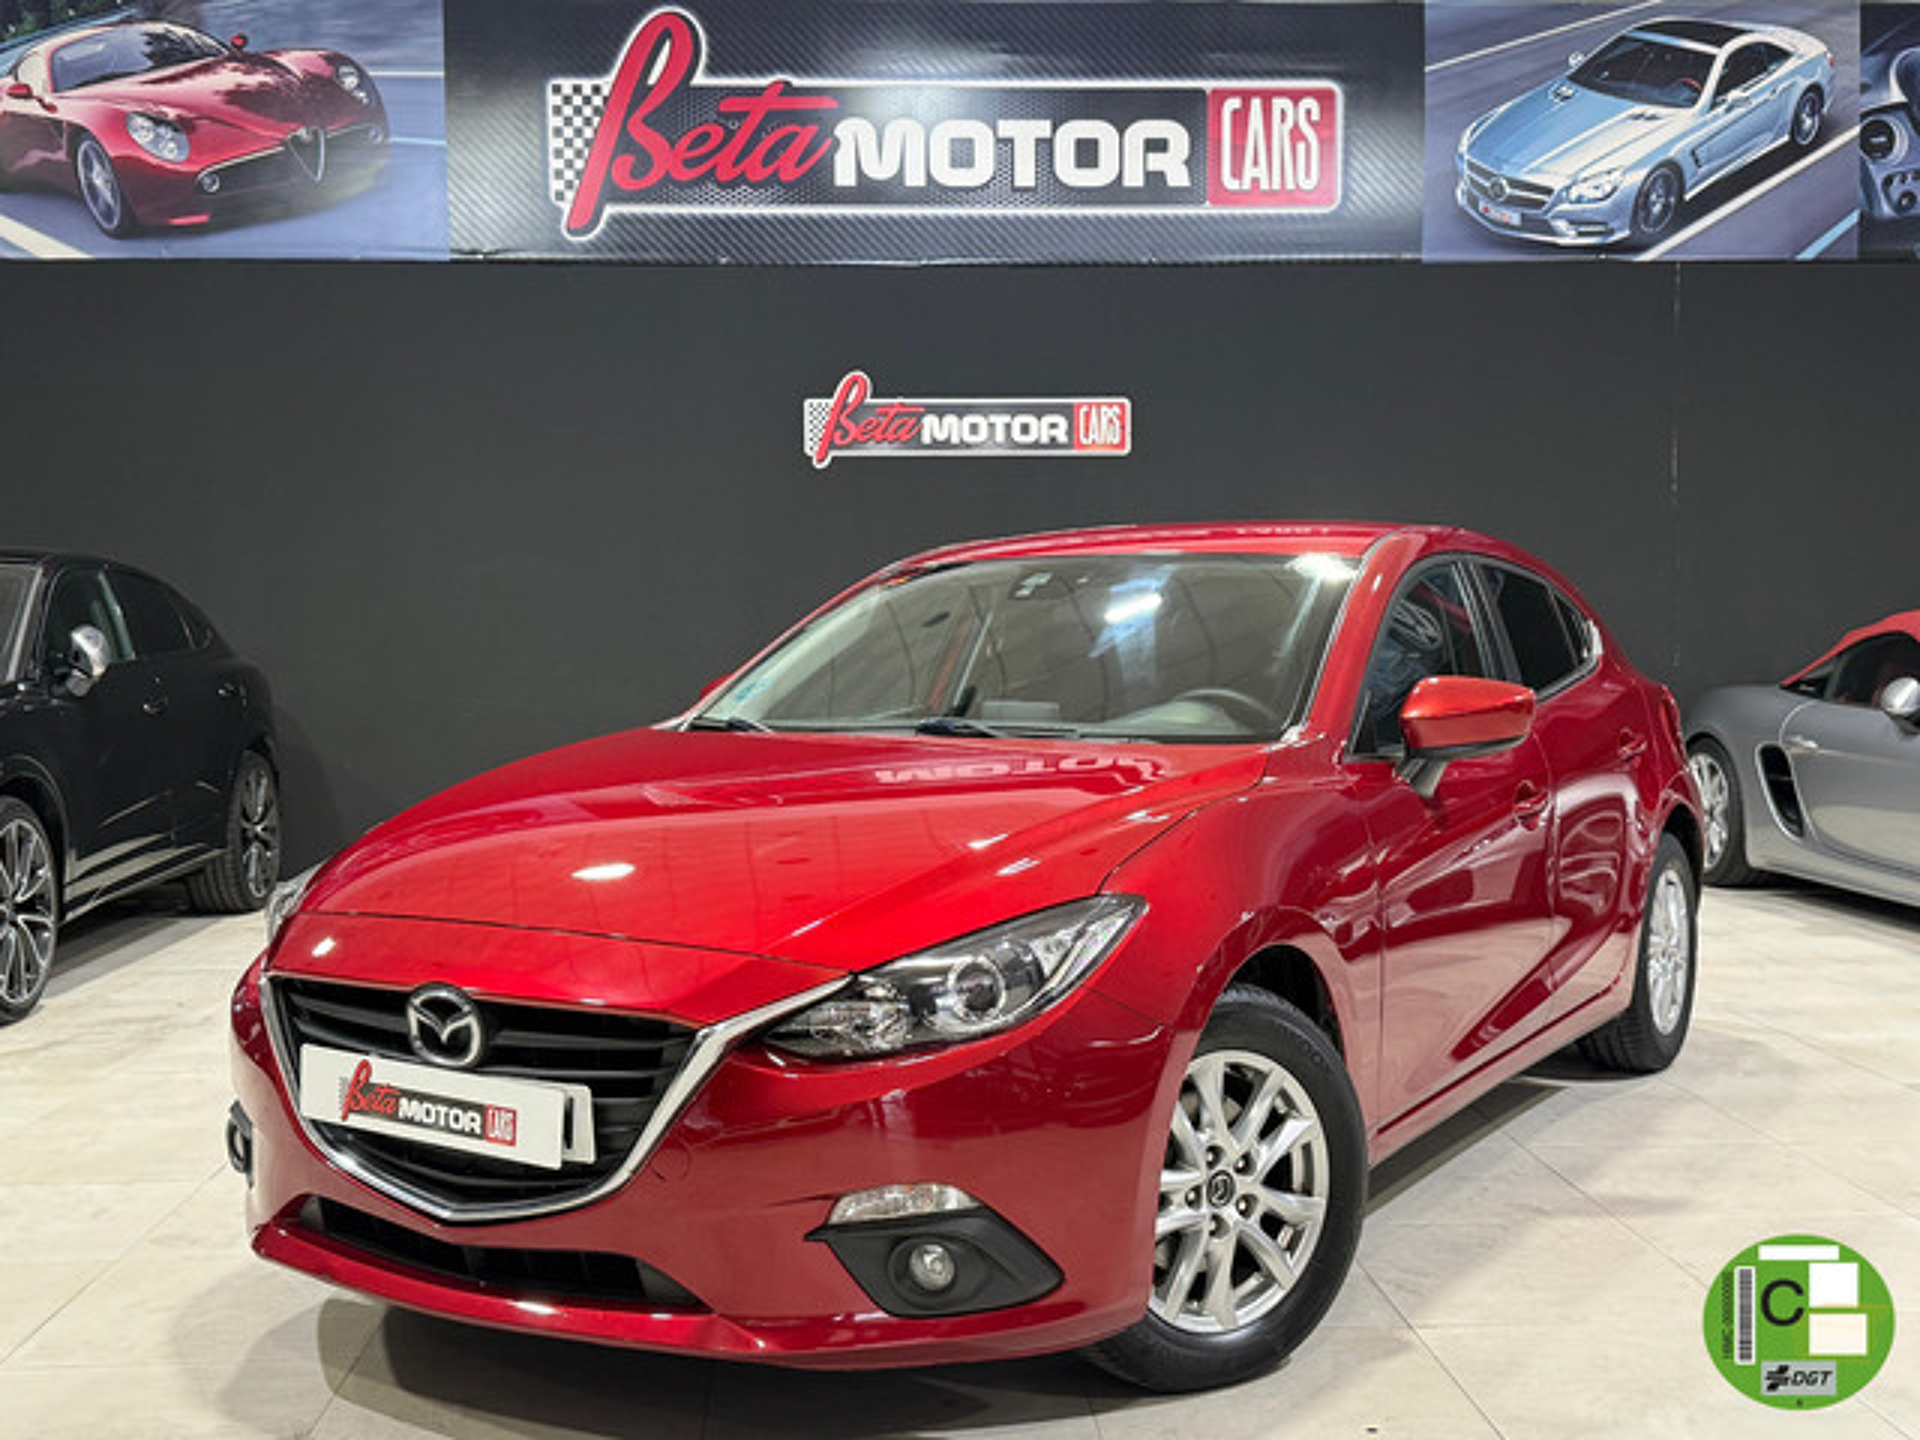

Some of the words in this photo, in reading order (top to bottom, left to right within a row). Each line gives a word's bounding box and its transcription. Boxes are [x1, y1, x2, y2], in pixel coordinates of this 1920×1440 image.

[564, 11, 838, 230] Beta
[833, 117, 1191, 188] MOTOR
[1221, 97, 1320, 193] CARS
[815, 374, 925, 462] Beta
[921, 413, 1069, 444] MOTOR
[1079, 404, 1121, 445] CARS
[341, 1059, 402, 1122] Beta
[398, 1097, 482, 1135] MOTOR
